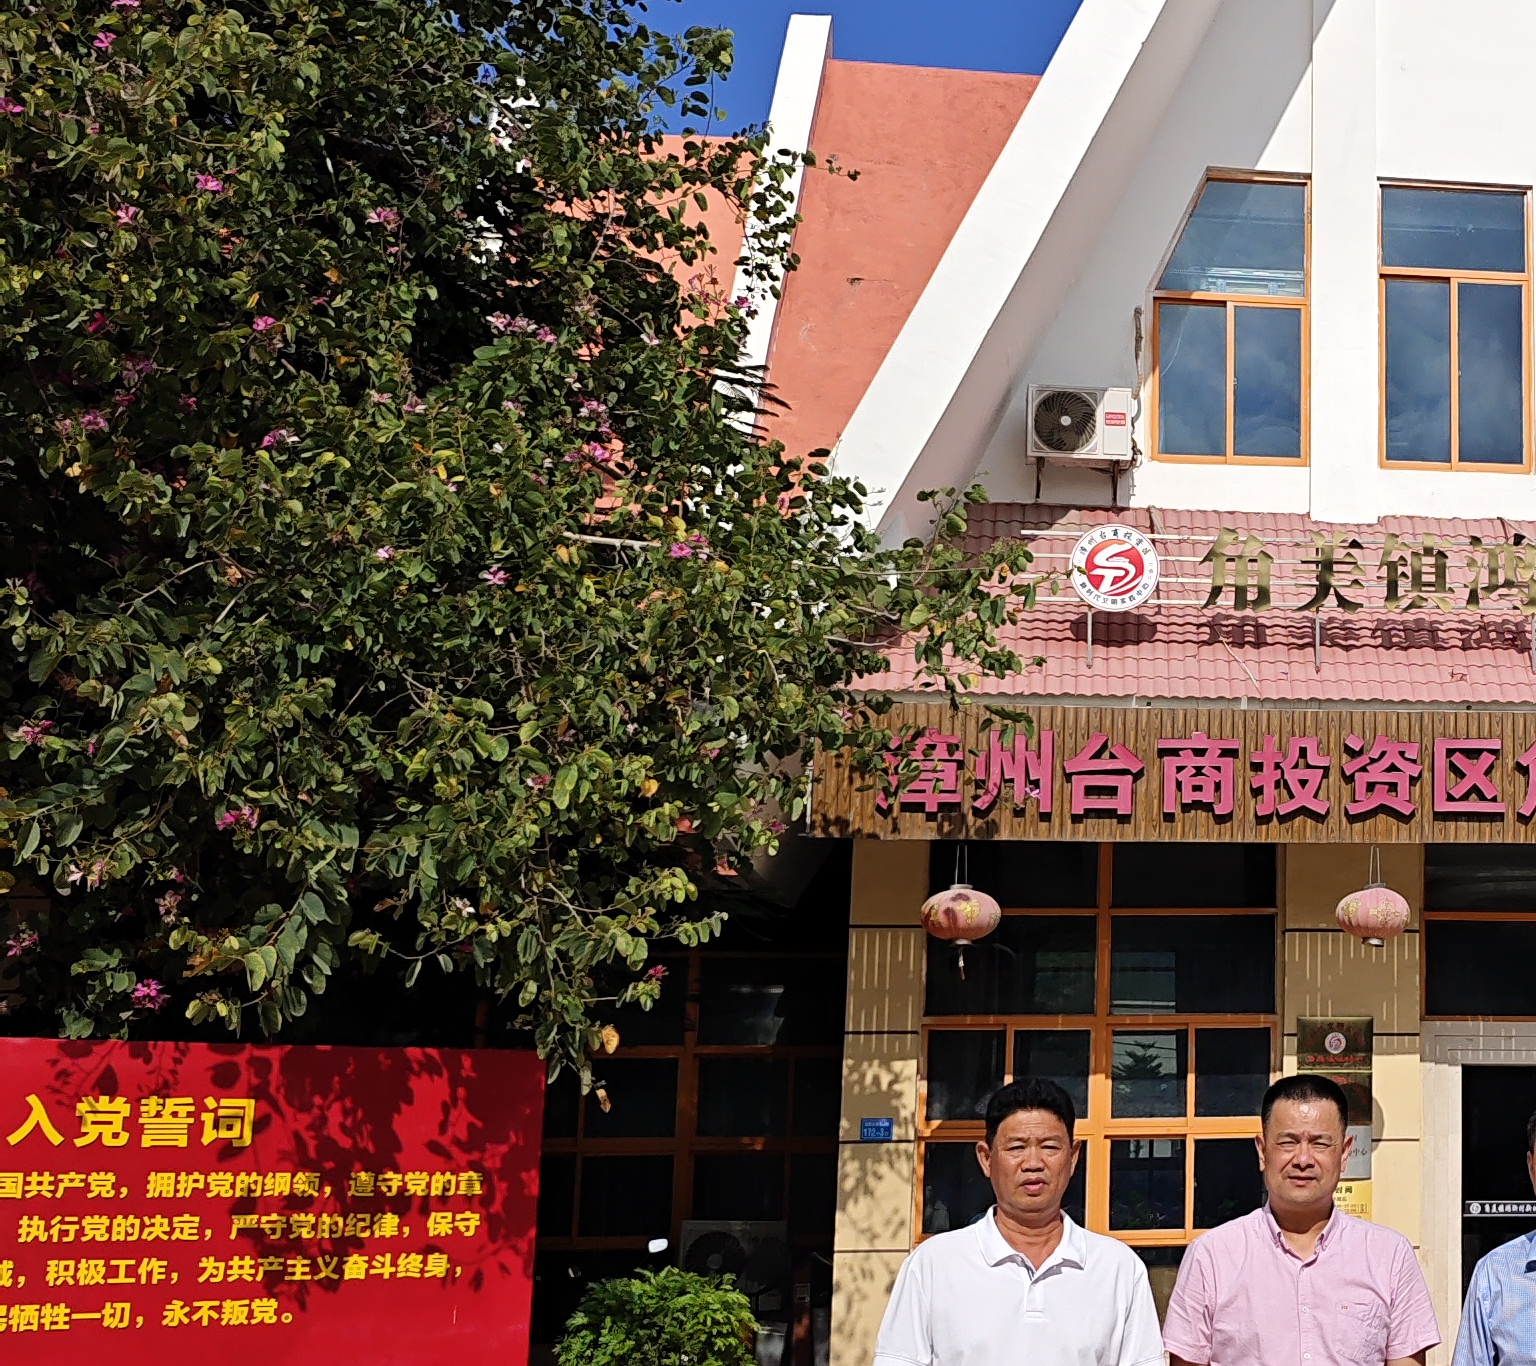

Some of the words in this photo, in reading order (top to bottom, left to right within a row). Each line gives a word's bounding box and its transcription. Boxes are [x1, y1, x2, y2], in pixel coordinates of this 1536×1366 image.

[7, 1094, 256, 1148] 入党誓词
[0, 1171, 484, 1199] 国共产党，拥护党的纲领，遵守党的章
[18, 1211, 481, 1243] 执行党的决定，严守党的纪律，保守
[0, 1298, 294, 1333] 牺牲一切，永不叛党。
